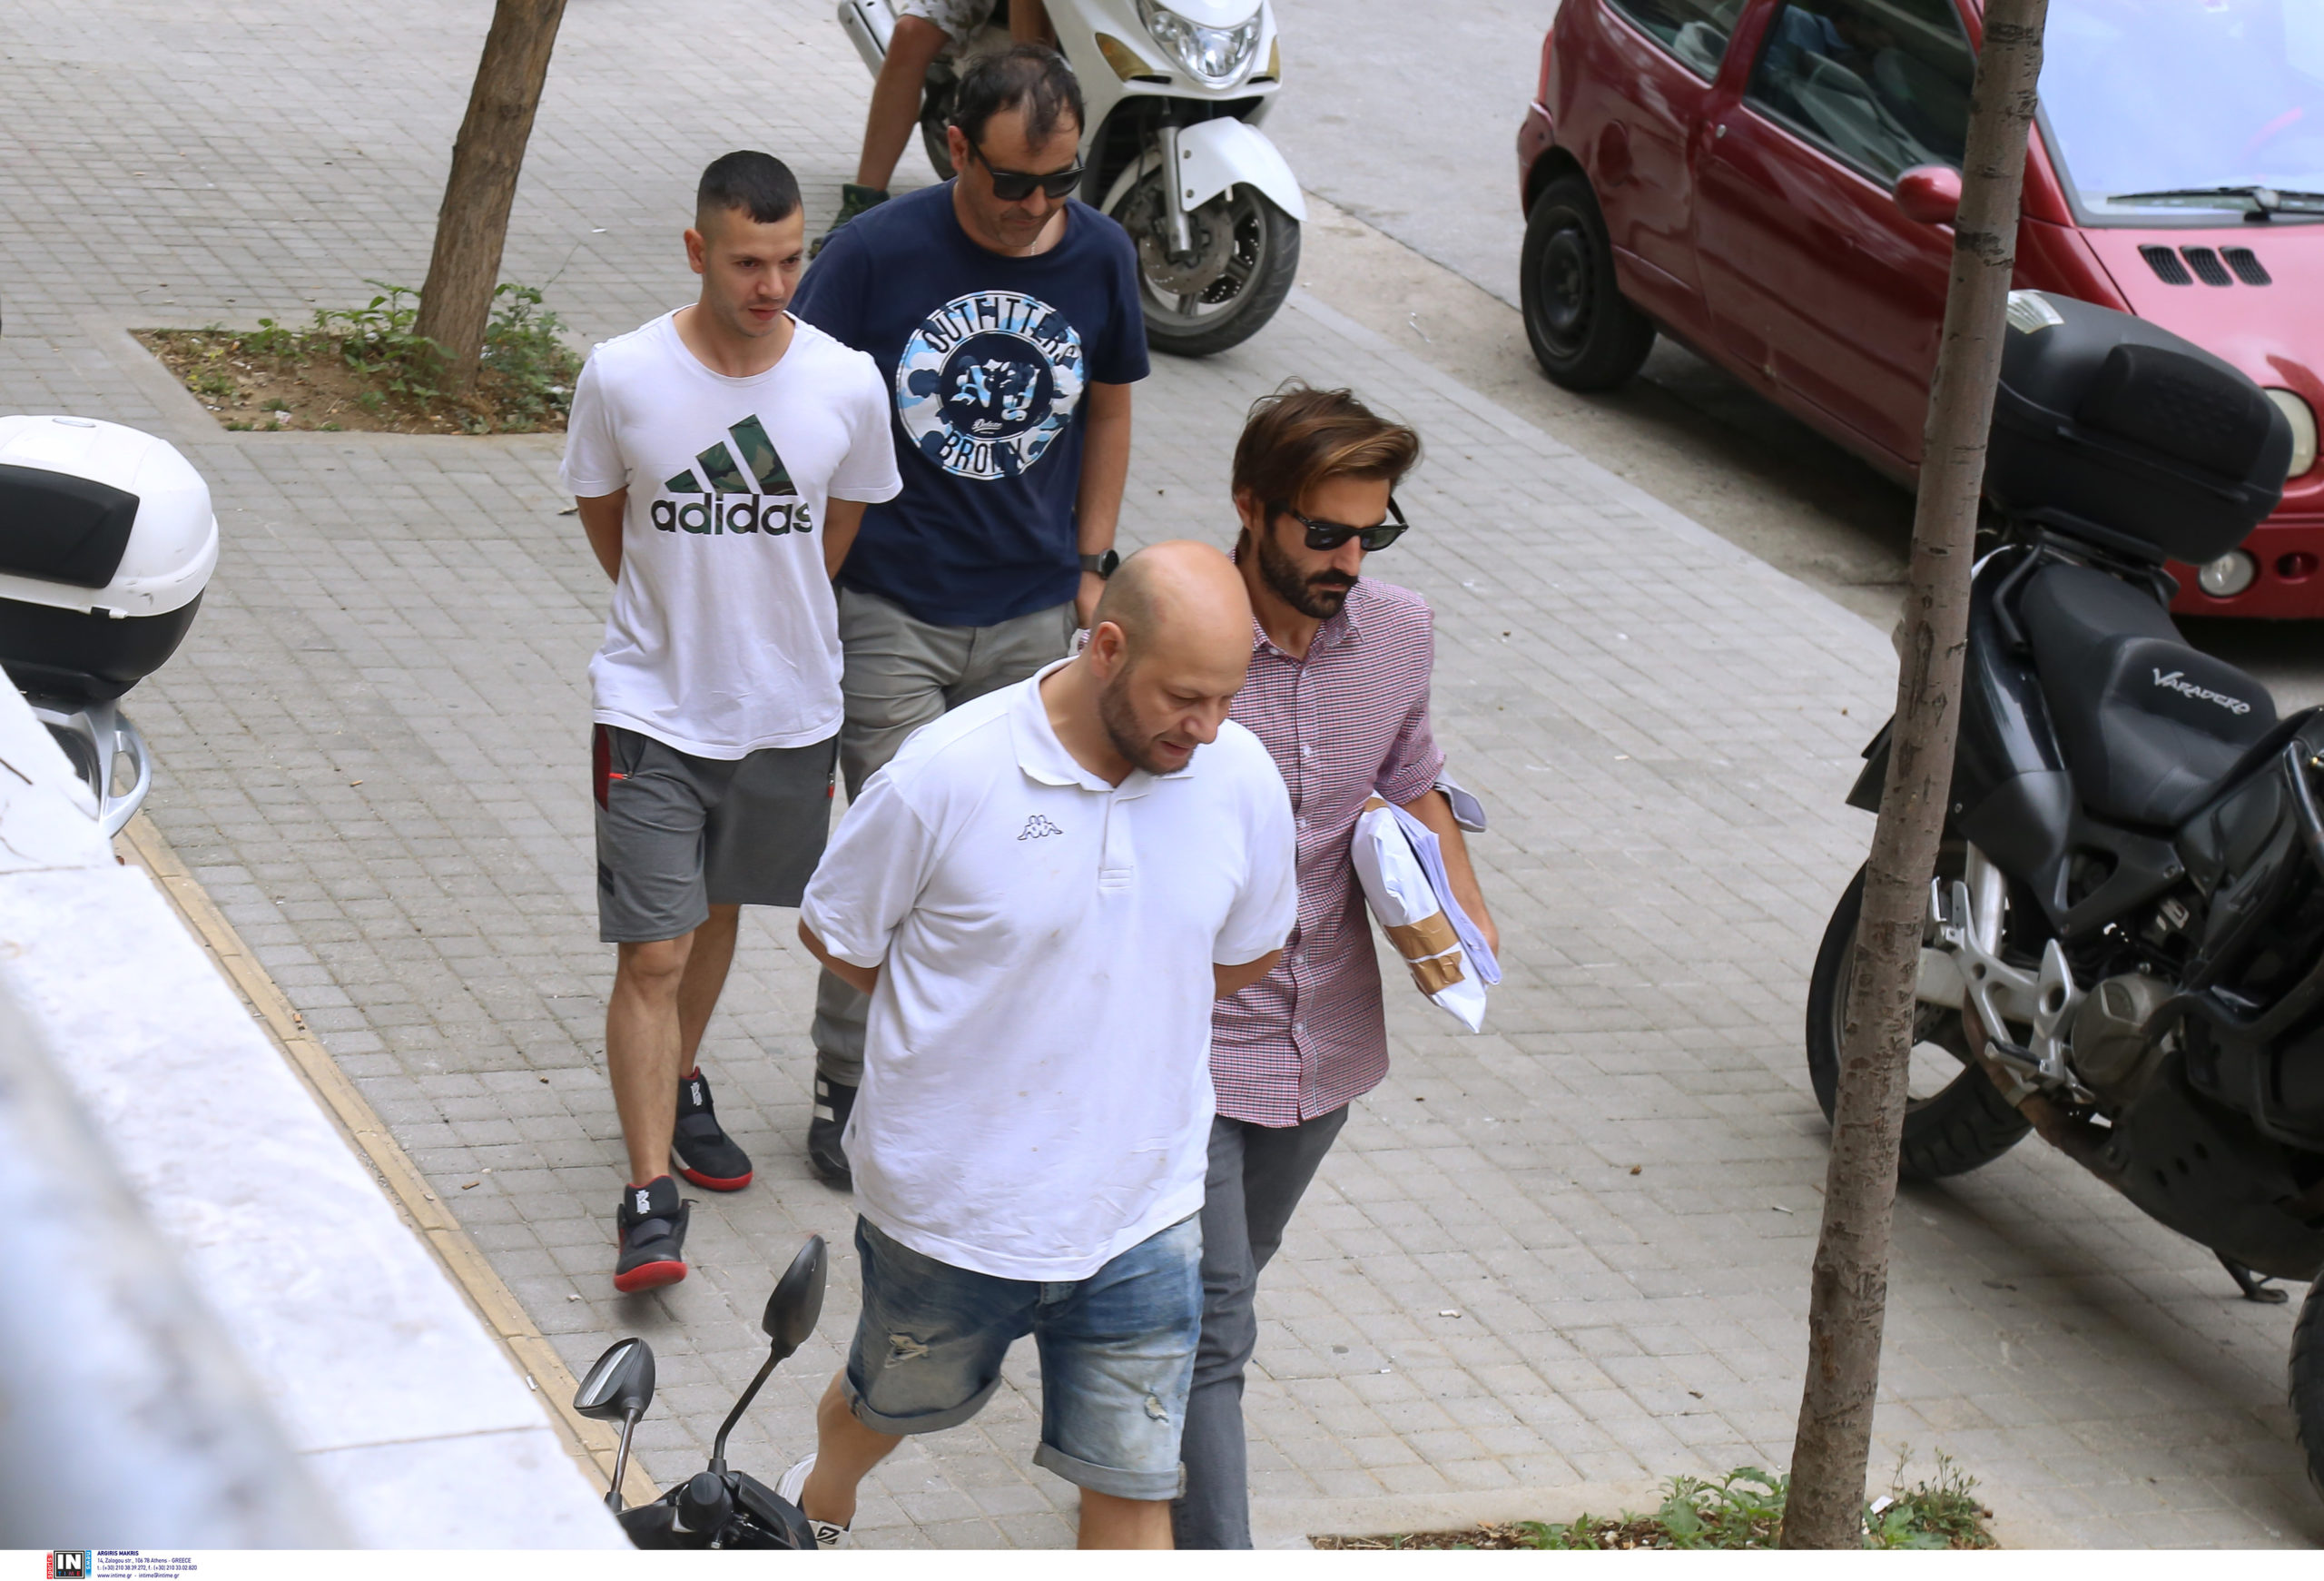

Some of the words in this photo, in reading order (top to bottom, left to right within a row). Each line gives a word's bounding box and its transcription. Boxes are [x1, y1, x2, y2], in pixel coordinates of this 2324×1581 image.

[921, 296, 1077, 367] OUTFITTERS
[939, 432, 1027, 473] BRONX
[651, 492, 813, 536] adidas
